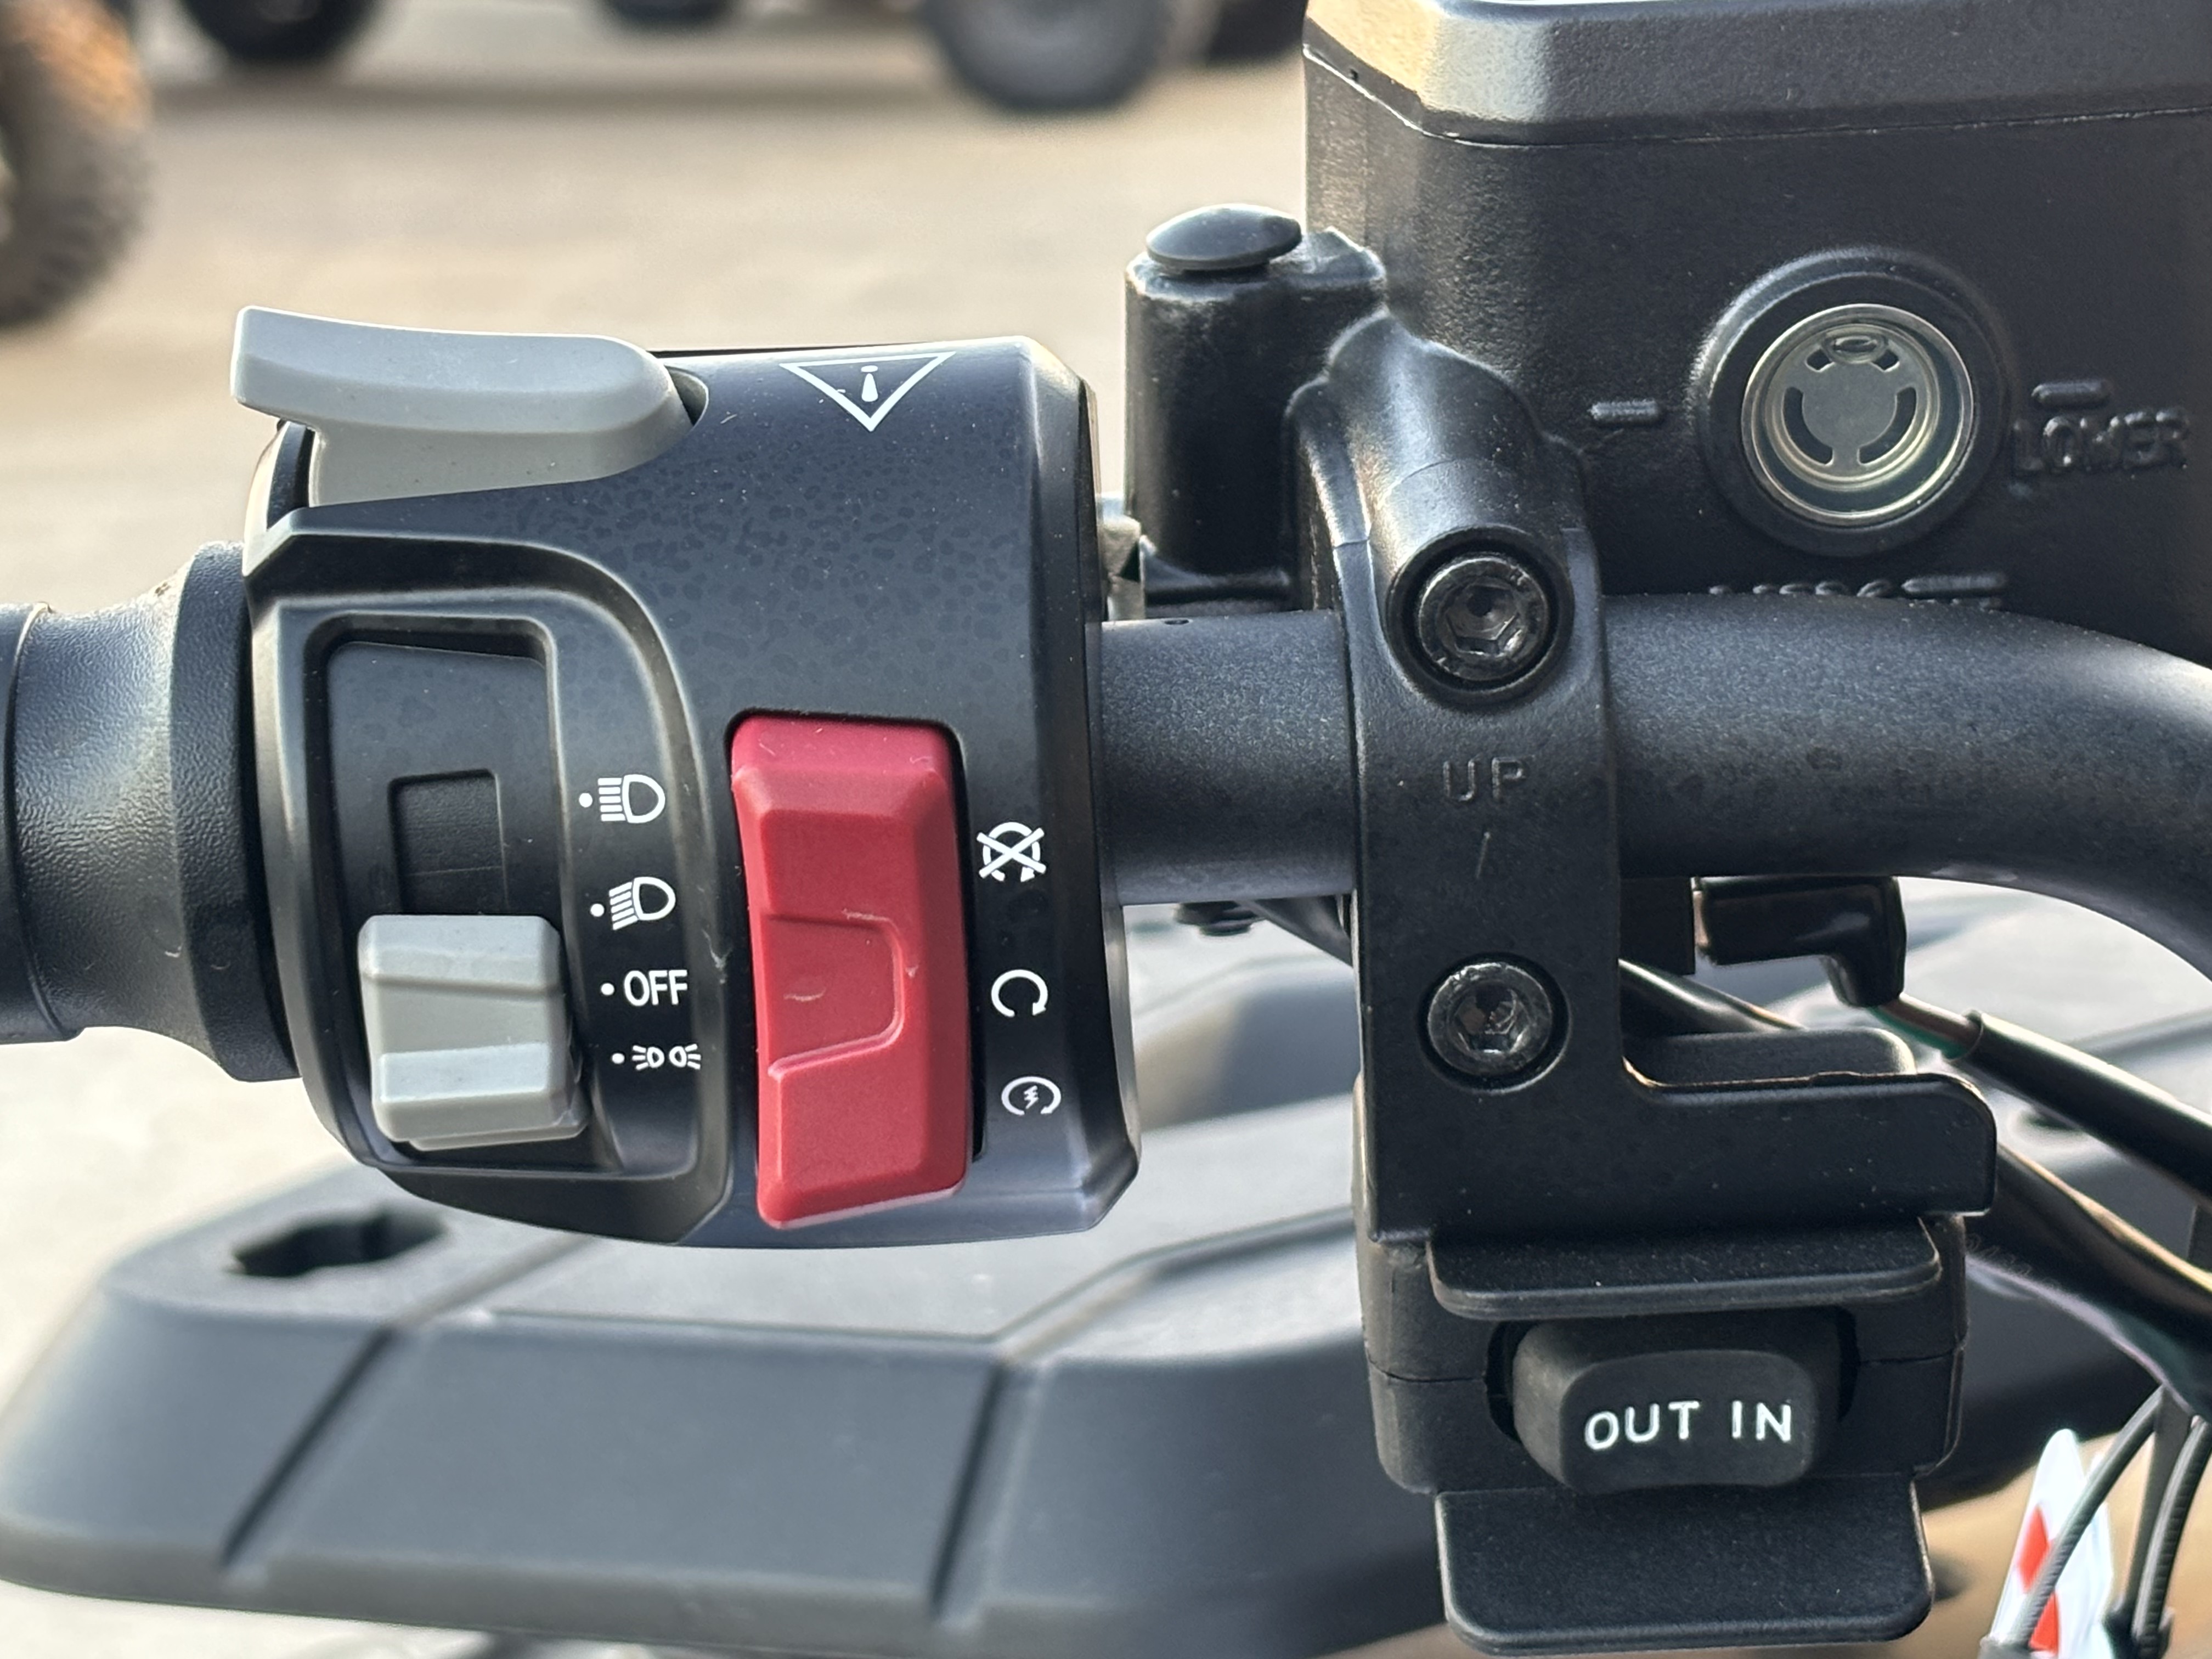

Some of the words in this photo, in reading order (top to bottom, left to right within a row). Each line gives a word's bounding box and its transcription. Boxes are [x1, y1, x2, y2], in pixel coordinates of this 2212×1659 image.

[2012, 410, 2189, 472] LOWER
[1442, 756, 1525, 803] UP
[624, 969, 688, 1007] OFF
[1584, 1400, 1700, 1451] OUT
[1731, 1400, 1792, 1442] IN
